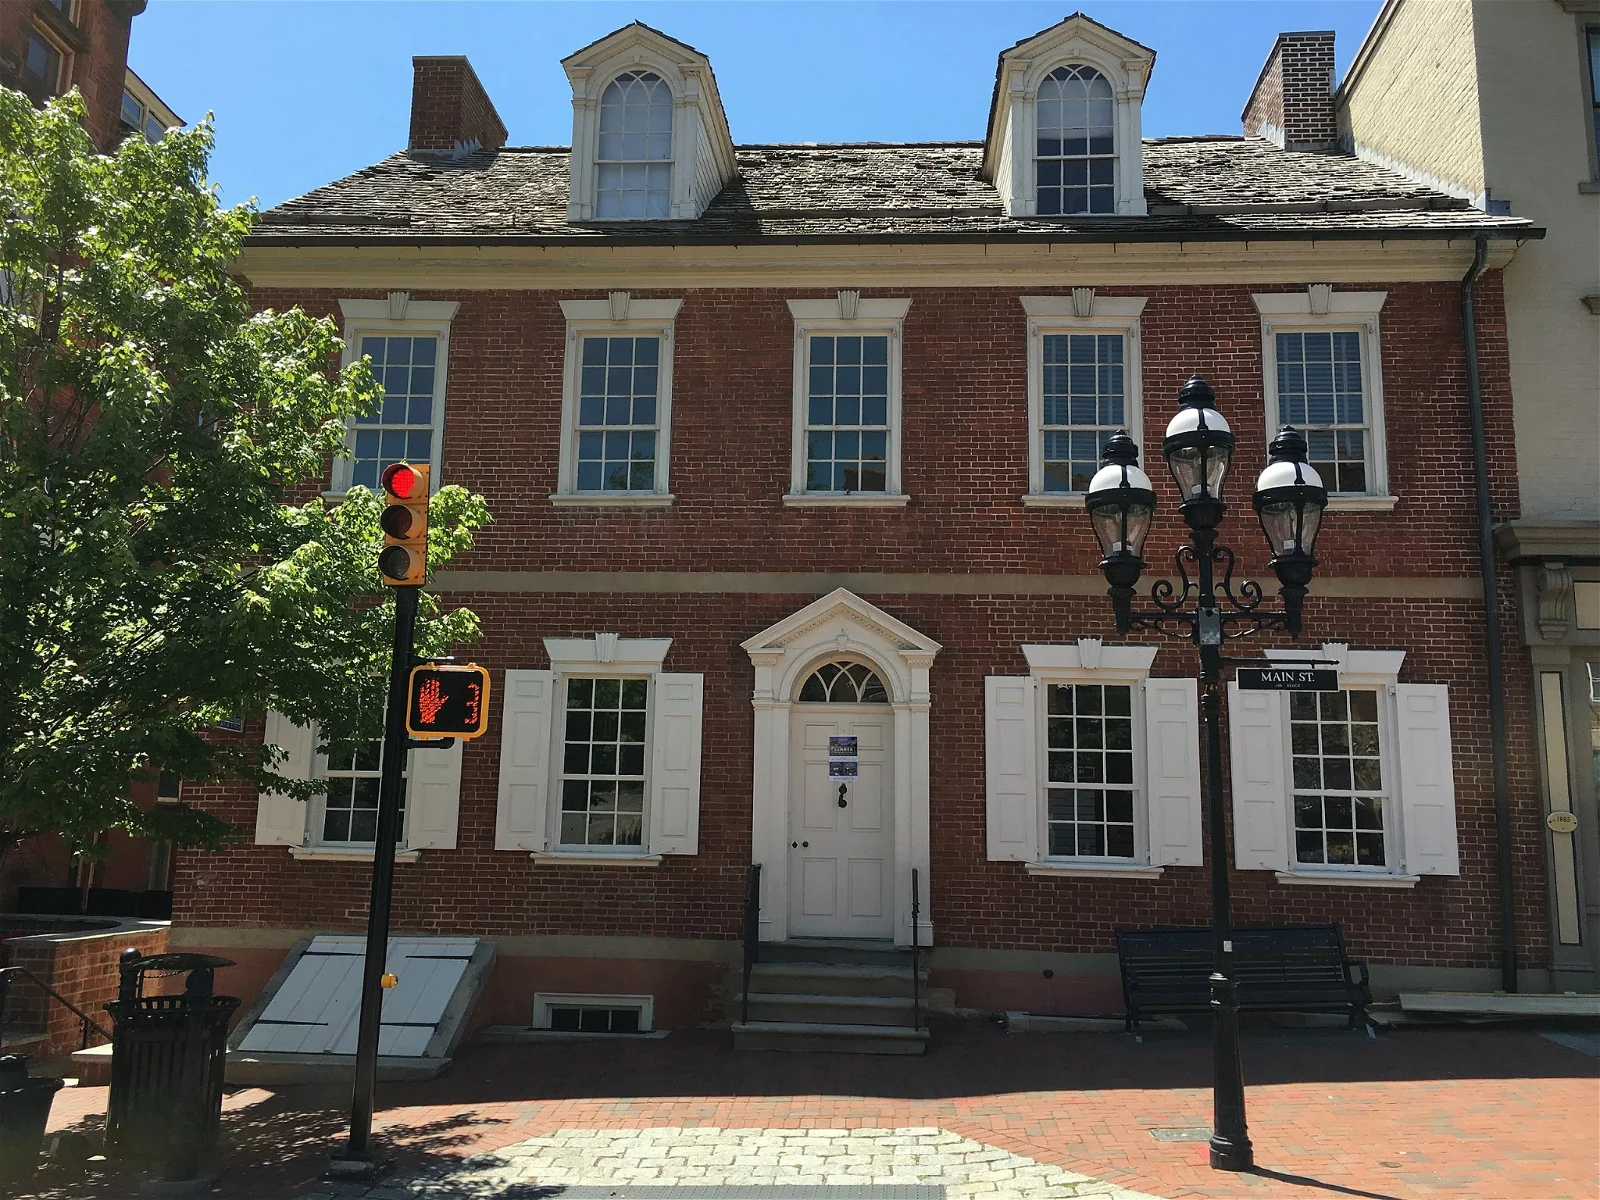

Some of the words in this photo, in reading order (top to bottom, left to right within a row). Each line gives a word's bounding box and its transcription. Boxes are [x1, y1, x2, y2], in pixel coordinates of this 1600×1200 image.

[1261, 672, 1294, 682] MAIN
[1299, 672, 1315, 682] ST.
[464, 682, 479, 723] 3
